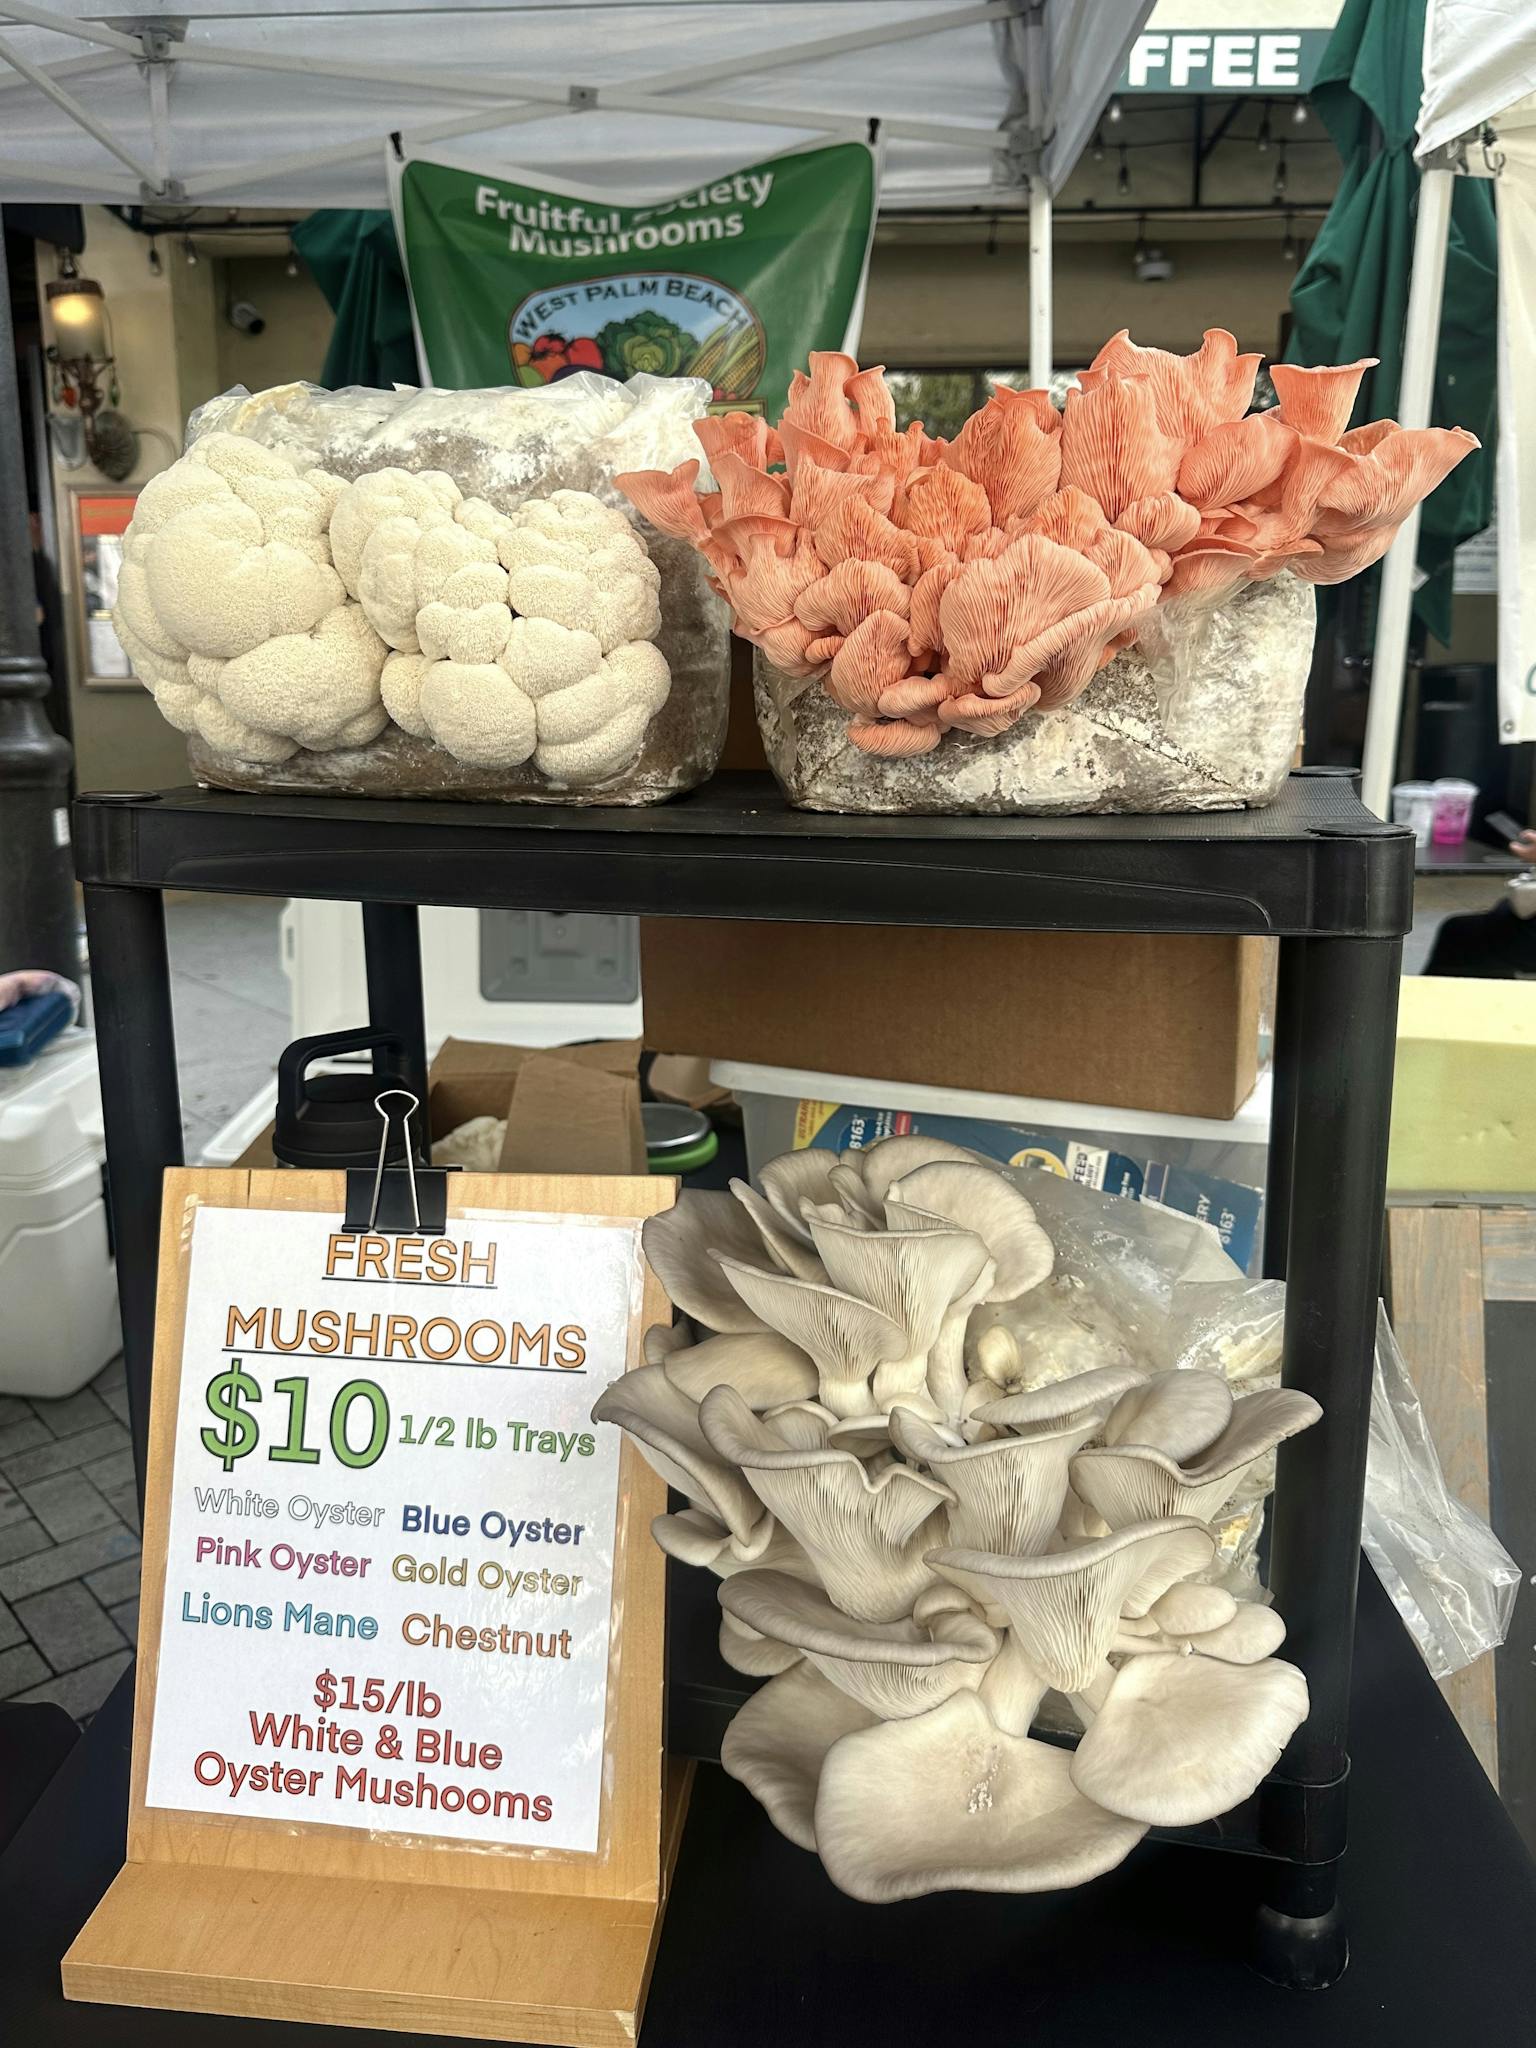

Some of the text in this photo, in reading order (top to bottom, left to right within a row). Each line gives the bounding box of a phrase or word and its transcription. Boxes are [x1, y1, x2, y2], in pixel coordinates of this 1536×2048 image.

[1128, 35, 1301, 87] FFEE
[476, 172, 775, 235] Fruitful ciety
[508, 212, 744, 258] Mushrooms
[516, 278, 749, 339] WEST PALM BEACH
[326, 1233, 498, 1285] FRESH
[225, 1305, 588, 1369] MUSHROOMS
[200, 1357, 596, 1472] $10 1/2 lb Trays
[194, 1486, 385, 1529] White Oyster
[401, 1504, 586, 1548] Blue Oyster
[195, 1536, 372, 1579] Pink Oyster
[391, 1553, 584, 1598] Gold Oyster
[181, 1591, 379, 1641] Lions Mane
[401, 1612, 573, 1660] Chestnut
[313, 1668, 442, 1719] $15/lb
[248, 1710, 503, 1771] White & Blue
[193, 1750, 553, 1822] Oyster Mushooms
